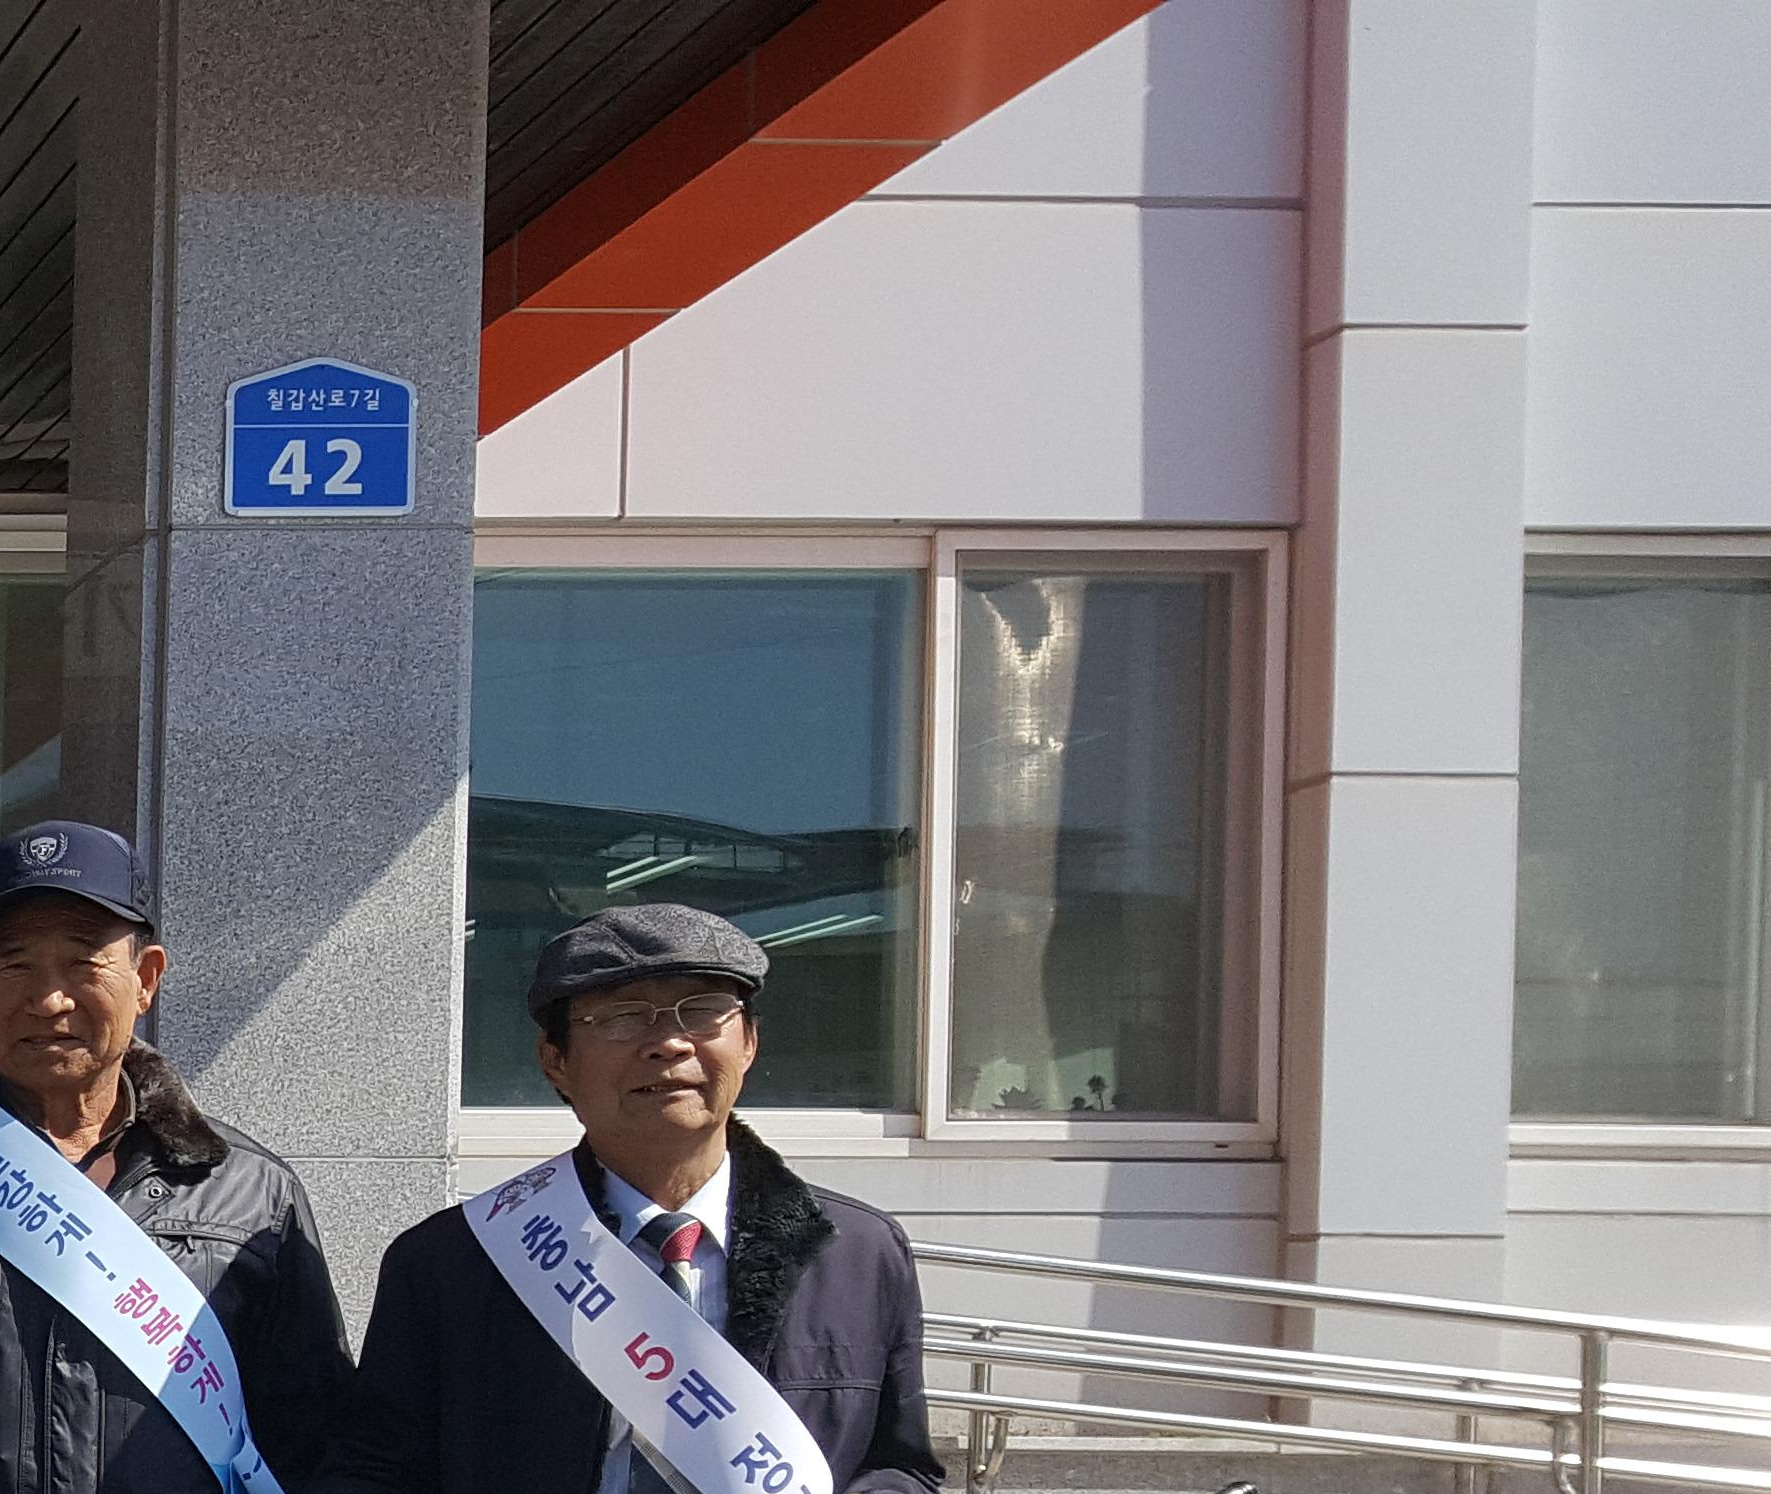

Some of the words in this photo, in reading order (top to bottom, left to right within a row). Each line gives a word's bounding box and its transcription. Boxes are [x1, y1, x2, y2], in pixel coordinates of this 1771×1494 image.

[266, 388, 381, 412] 칠갑산로7길
[268, 439, 363, 496] 42
[520, 1215, 616, 1322] 충남
[624, 1332, 737, 1430] 5대
